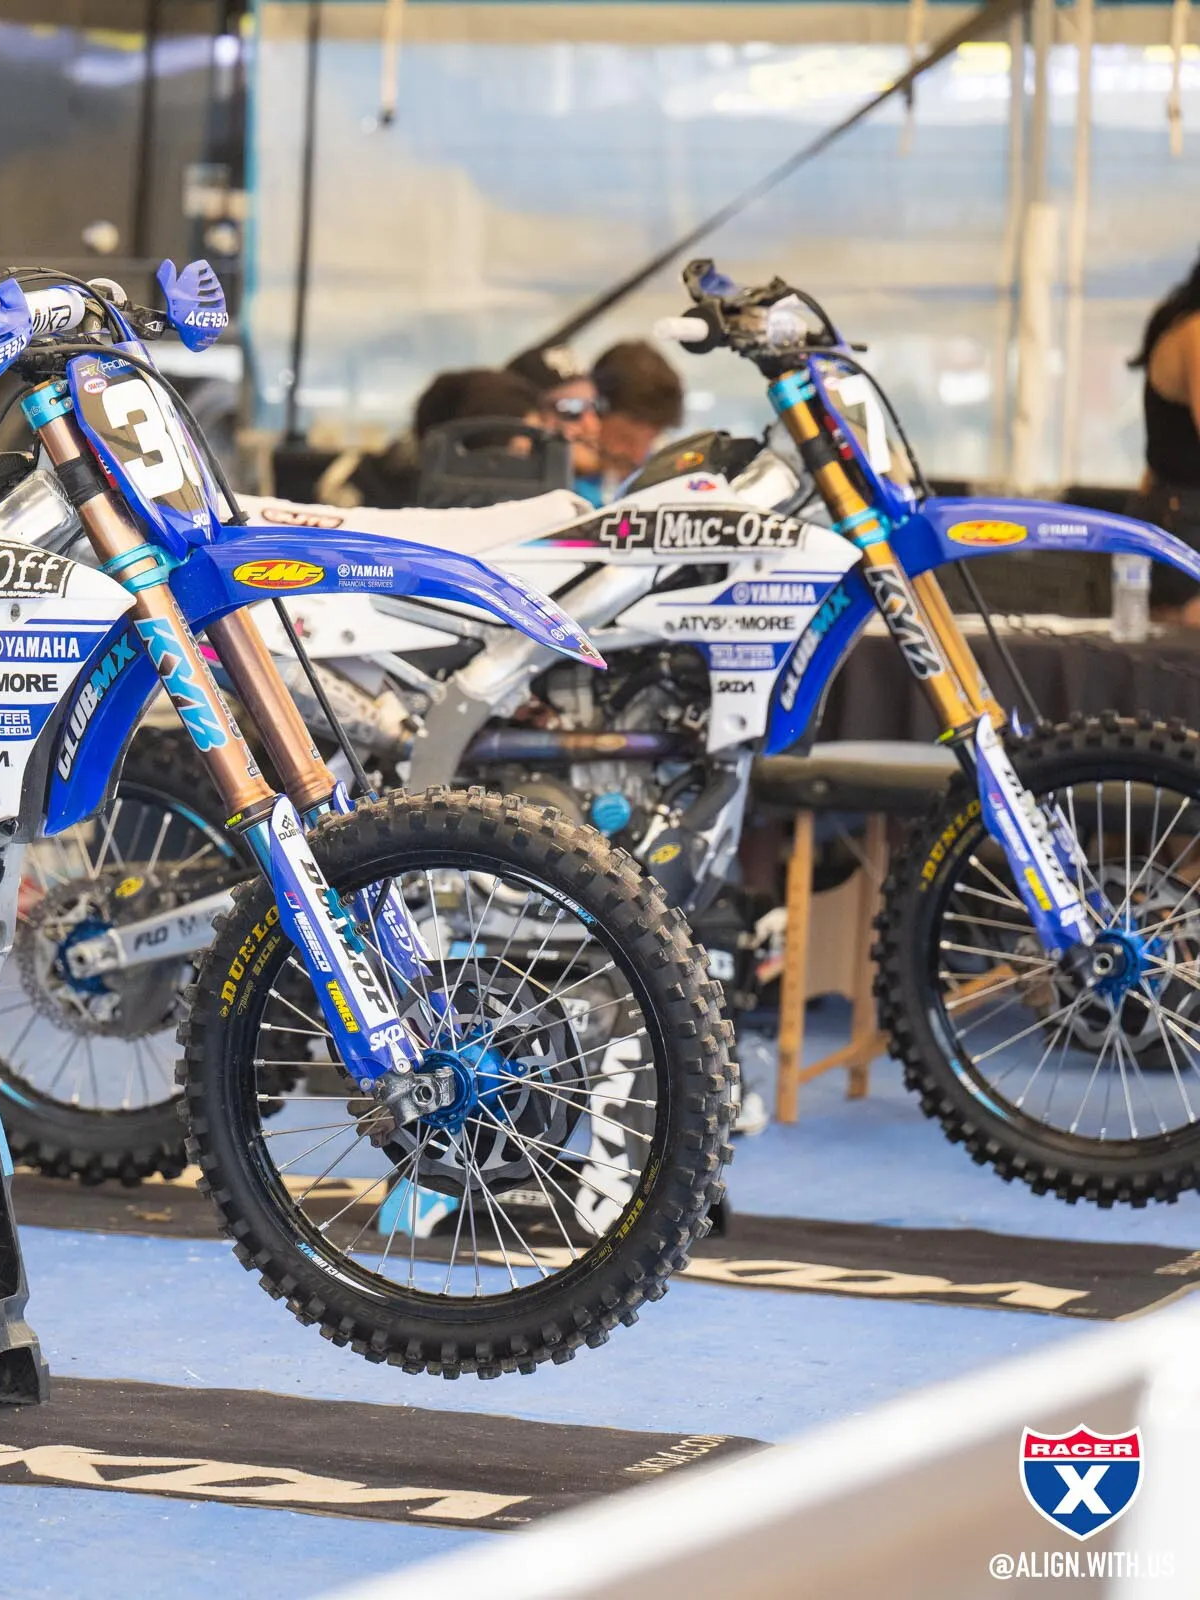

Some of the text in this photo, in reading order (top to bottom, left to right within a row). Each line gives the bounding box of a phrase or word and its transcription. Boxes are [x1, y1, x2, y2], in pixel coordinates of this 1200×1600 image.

[661, 513, 799, 549] Muc-Off
[234, 565, 324, 583] FMF
[351, 565, 394, 577] YAMAHA
[751, 584, 816, 604] YAMAHA
[864, 563, 943, 680] KYB
[5, 636, 80, 658] YAMAHA
[57, 633, 137, 783] CLUBMX
[553, 889, 595, 924] CLUBMX
[221, 905, 280, 1006] DUNLO
[252, 935, 281, 976] EXCEL
[615, 1198, 644, 1239] EXCEL
[298, 1242, 339, 1276] CLUBMX
